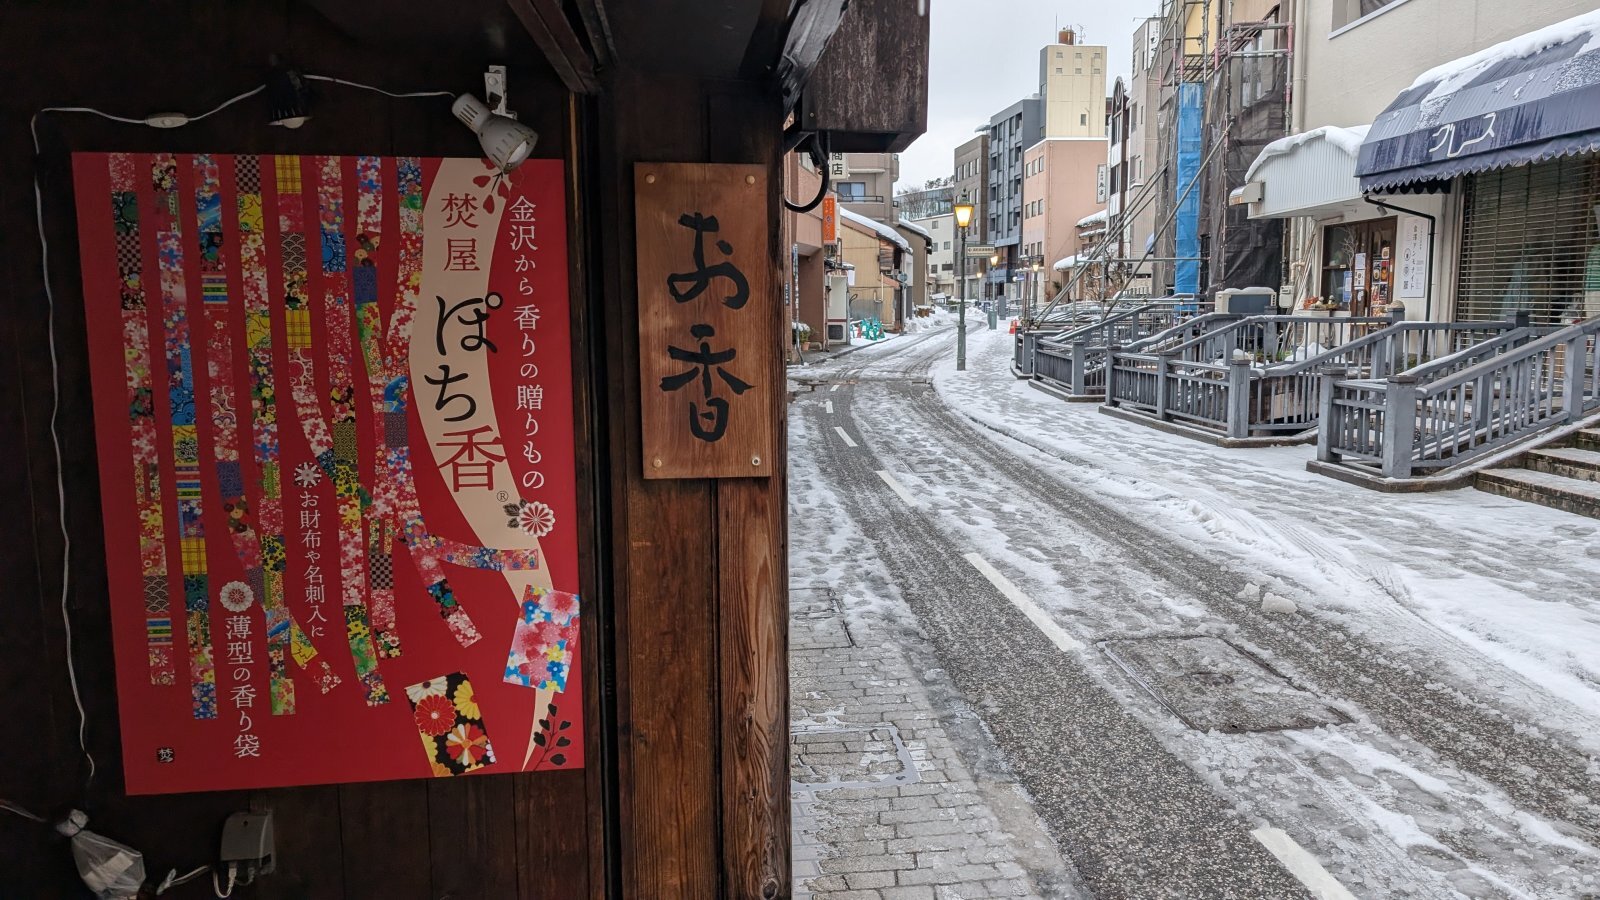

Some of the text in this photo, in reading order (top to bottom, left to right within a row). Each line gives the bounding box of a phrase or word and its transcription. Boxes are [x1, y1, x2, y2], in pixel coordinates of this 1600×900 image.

[424, 192, 507, 493] 焚屋 ぽち香
[508, 195, 546, 490] 金沢から香りの贈りもの
[659, 212, 756, 442] お香
[225, 615, 262, 759] 薄型の香り袋
